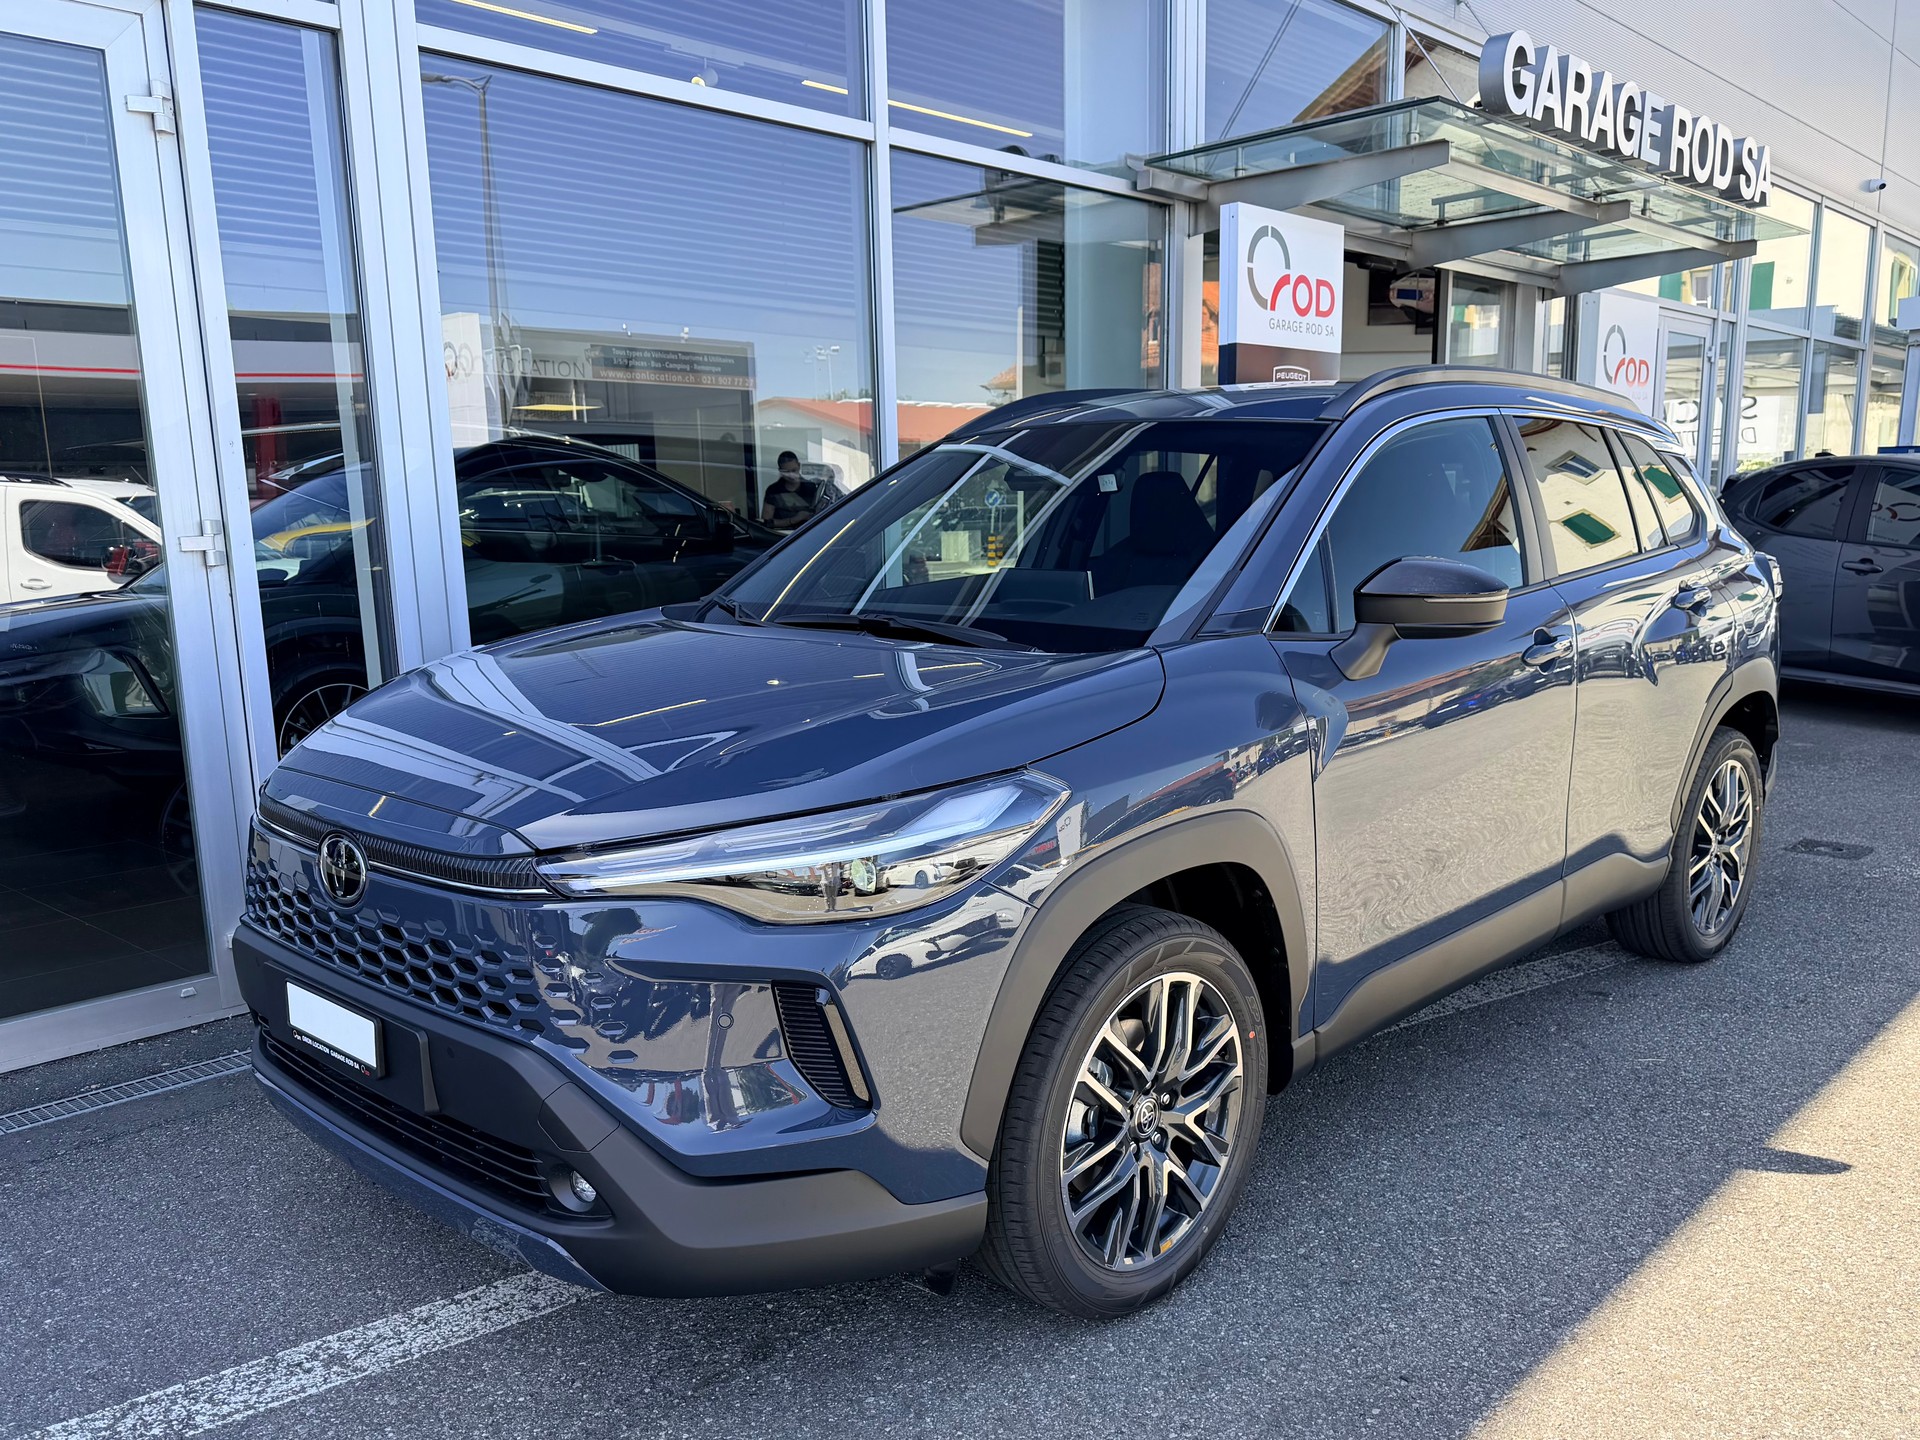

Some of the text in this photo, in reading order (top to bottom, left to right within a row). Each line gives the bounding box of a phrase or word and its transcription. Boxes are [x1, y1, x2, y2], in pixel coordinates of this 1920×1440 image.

[1503, 30, 1771, 203] GARAGE ROD SA
[1269, 318, 1335, 337] GARAGE ROD SA
[612, 347, 626, 356] Tous
[626, 349, 643, 359] types
[643, 350, 651, 358] de
[628, 359, 647, 367] places
[665, 361, 690, 371] Camping
[599, 369, 695, 383] www.oronlocation.ch
[701, 376, 716, 384] 021
[1276, 372, 1307, 381] PEUGEOT
[312, 1041, 329, 1054] LOCATION
[330, 1049, 346, 1063] GARAGE
